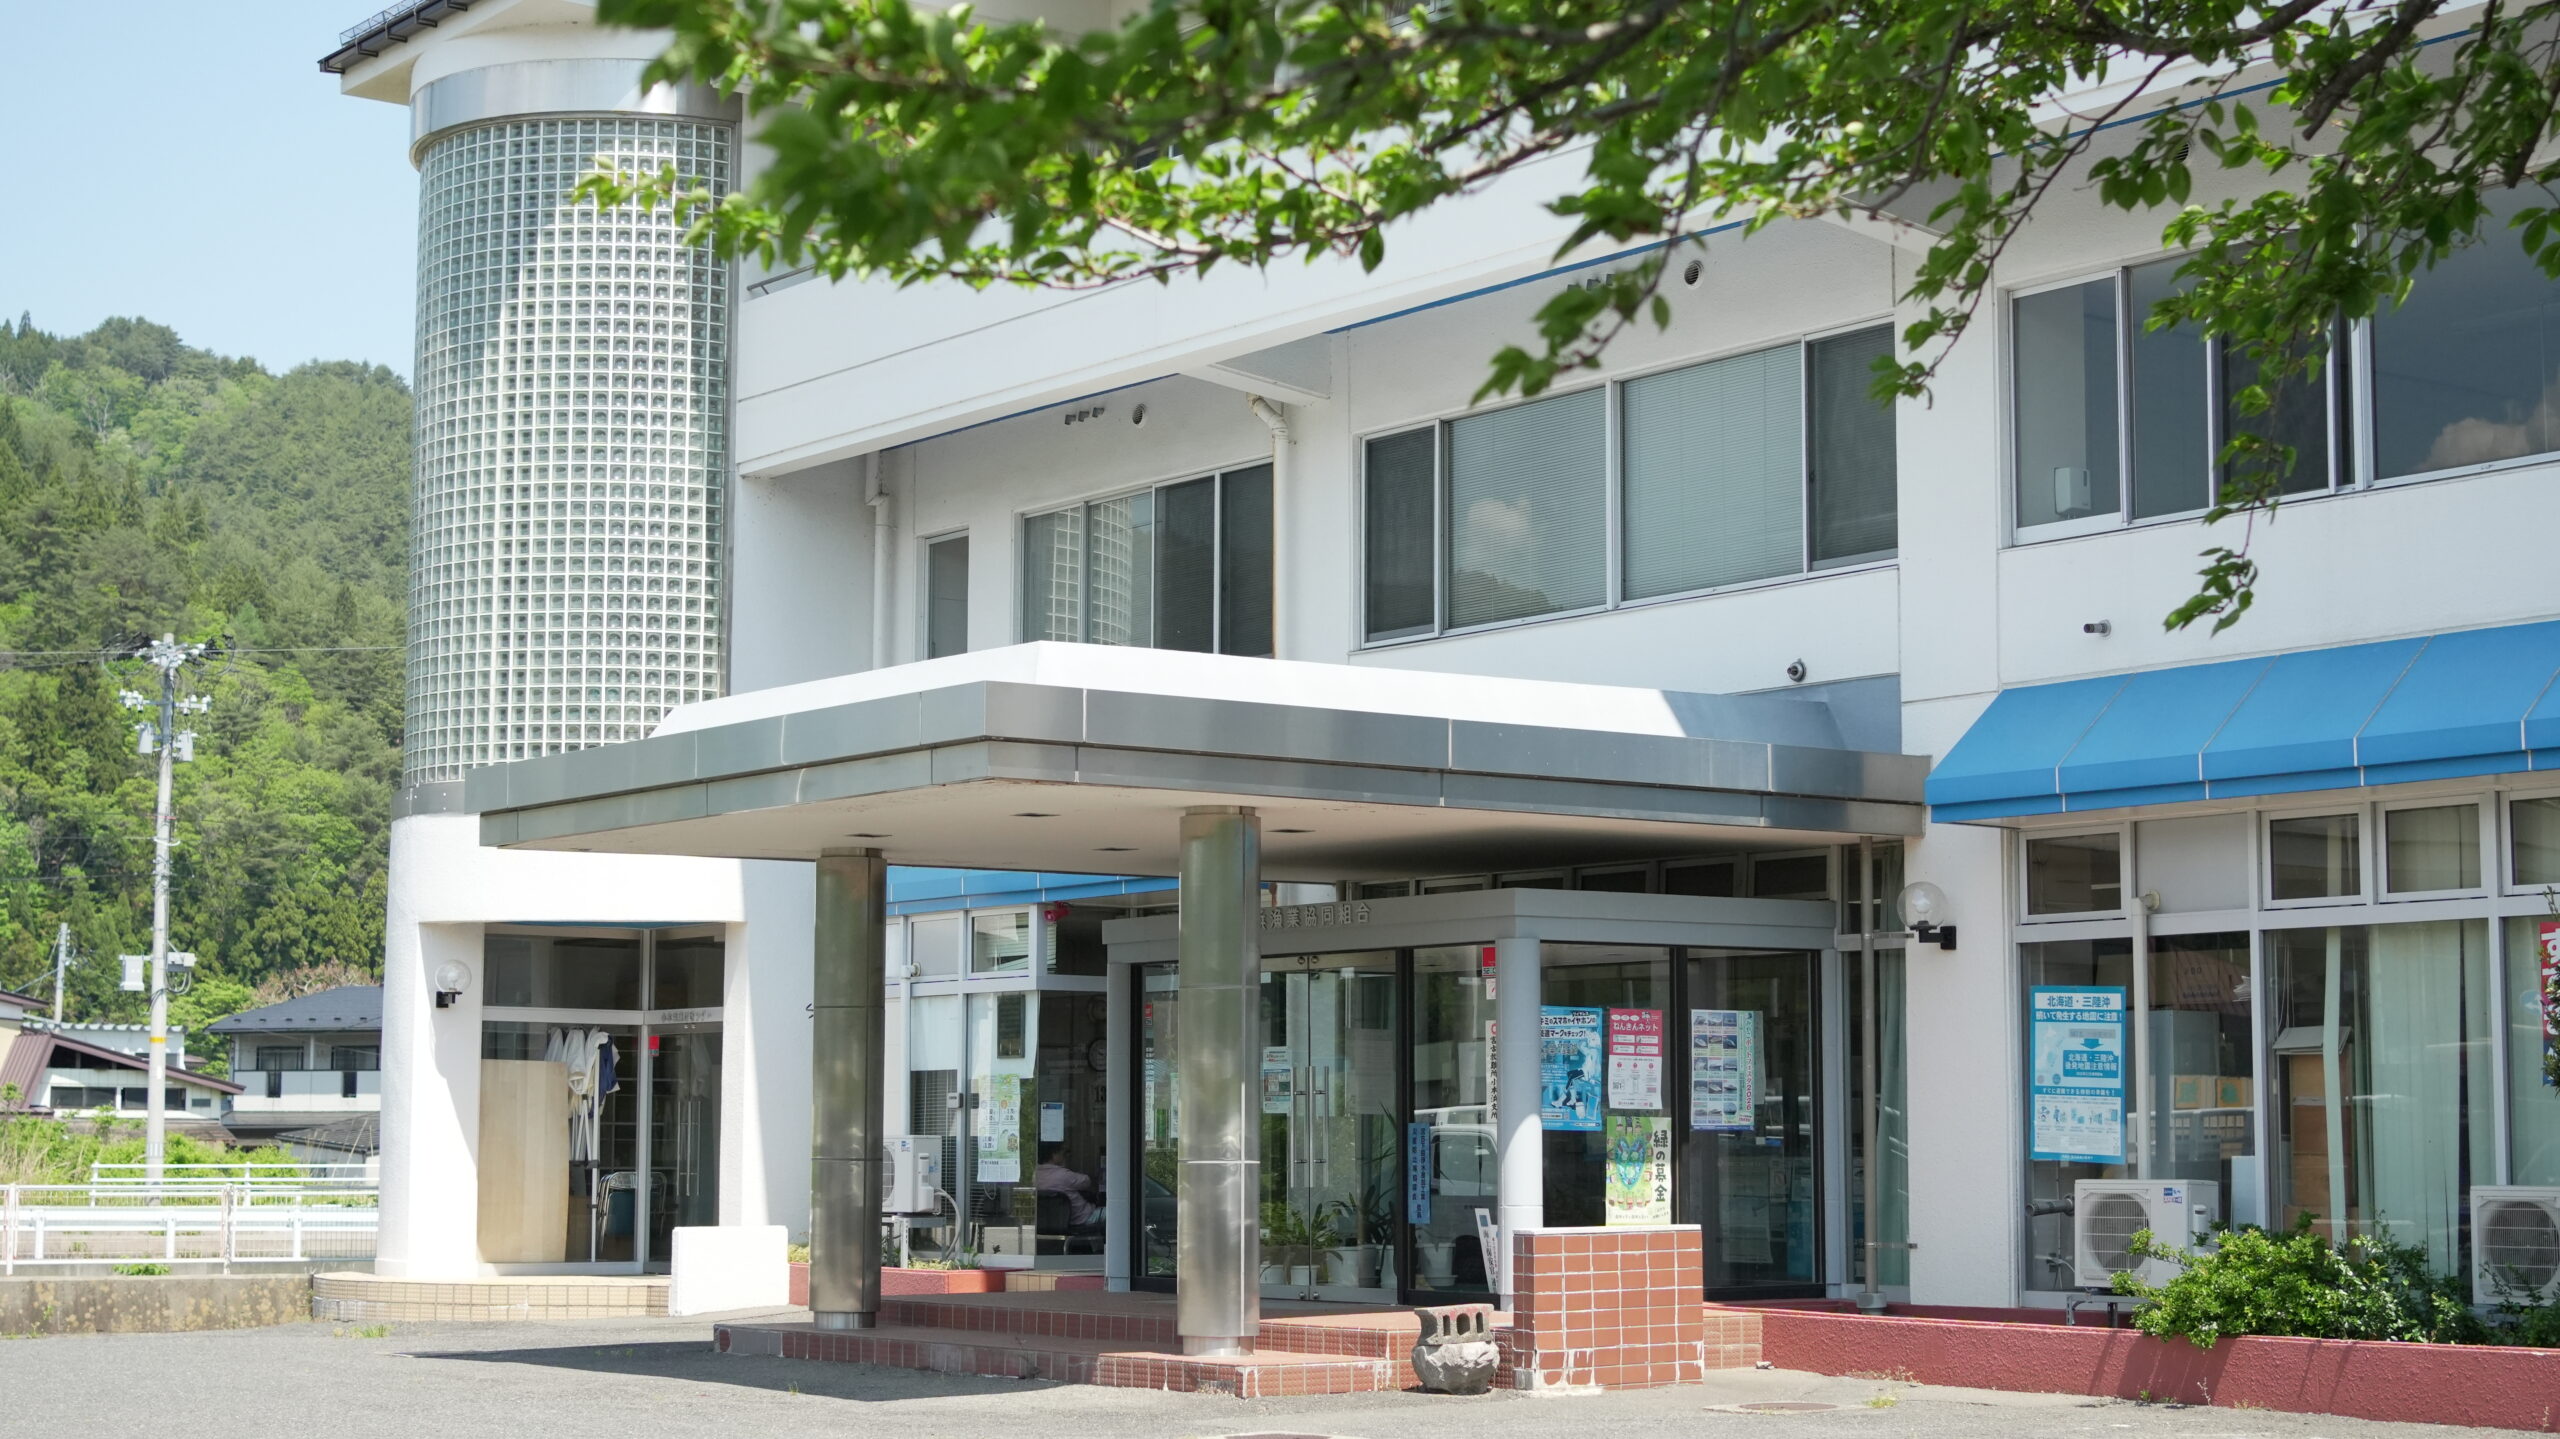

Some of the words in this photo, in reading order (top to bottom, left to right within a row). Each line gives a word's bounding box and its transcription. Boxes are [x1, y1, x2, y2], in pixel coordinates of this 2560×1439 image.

[2047, 995, 2111, 1008] 北海道・三陸沖
[1613, 1022, 1658, 1031] ねんきんネット
[1653, 1129, 1669, 1202] 緑の募金
